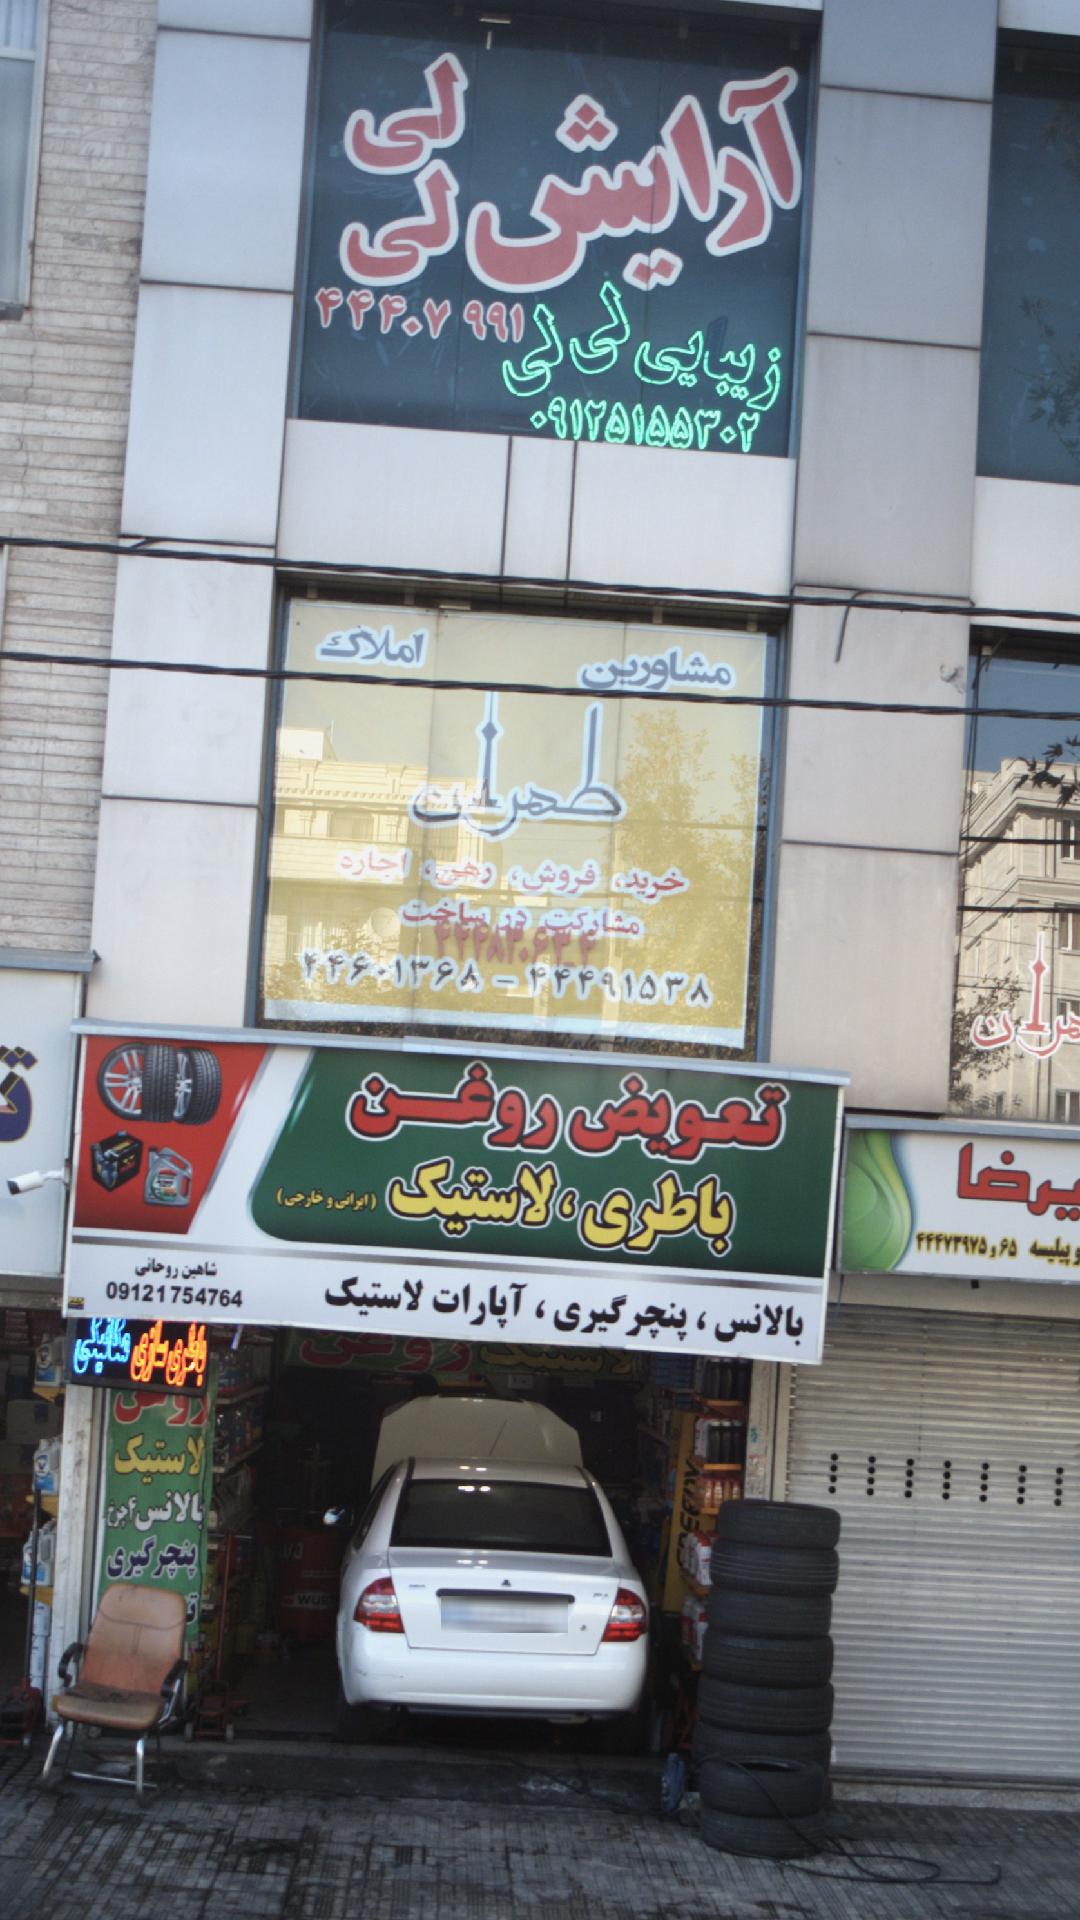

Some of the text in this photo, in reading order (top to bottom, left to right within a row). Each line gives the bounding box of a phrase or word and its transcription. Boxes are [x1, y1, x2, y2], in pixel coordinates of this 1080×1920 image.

[340, 52, 801, 292] آرایش لی لی
[502, 280, 782, 412] زیبایی لی لی
[529, 396, 761, 453] ۰۹۱۲۵۱۵۵۳۰۲
[581, 652, 734, 691] مشاورین
[413, 690, 623, 837] طهران
[339, 850, 409, 878] اجاره
[402, 901, 642, 935] مشارکت در ساخت
[529, 965, 710, 1004] ۴۴۴۹۱۵۳۸
[346, 1060, 790, 1165] تعویض روغن
[386, 1155, 559, 1238] لاستیک
[134, 1256, 218, 1281] شاهین روحانی
[105, 1281, 243, 1308] 09121754764
[324, 1276, 424, 1316] لاستیک
[432, 1282, 526, 1328] آپارات
[113, 1434, 205, 1485] لاستیک
[134, 1490, 203, 1531] بالانس
